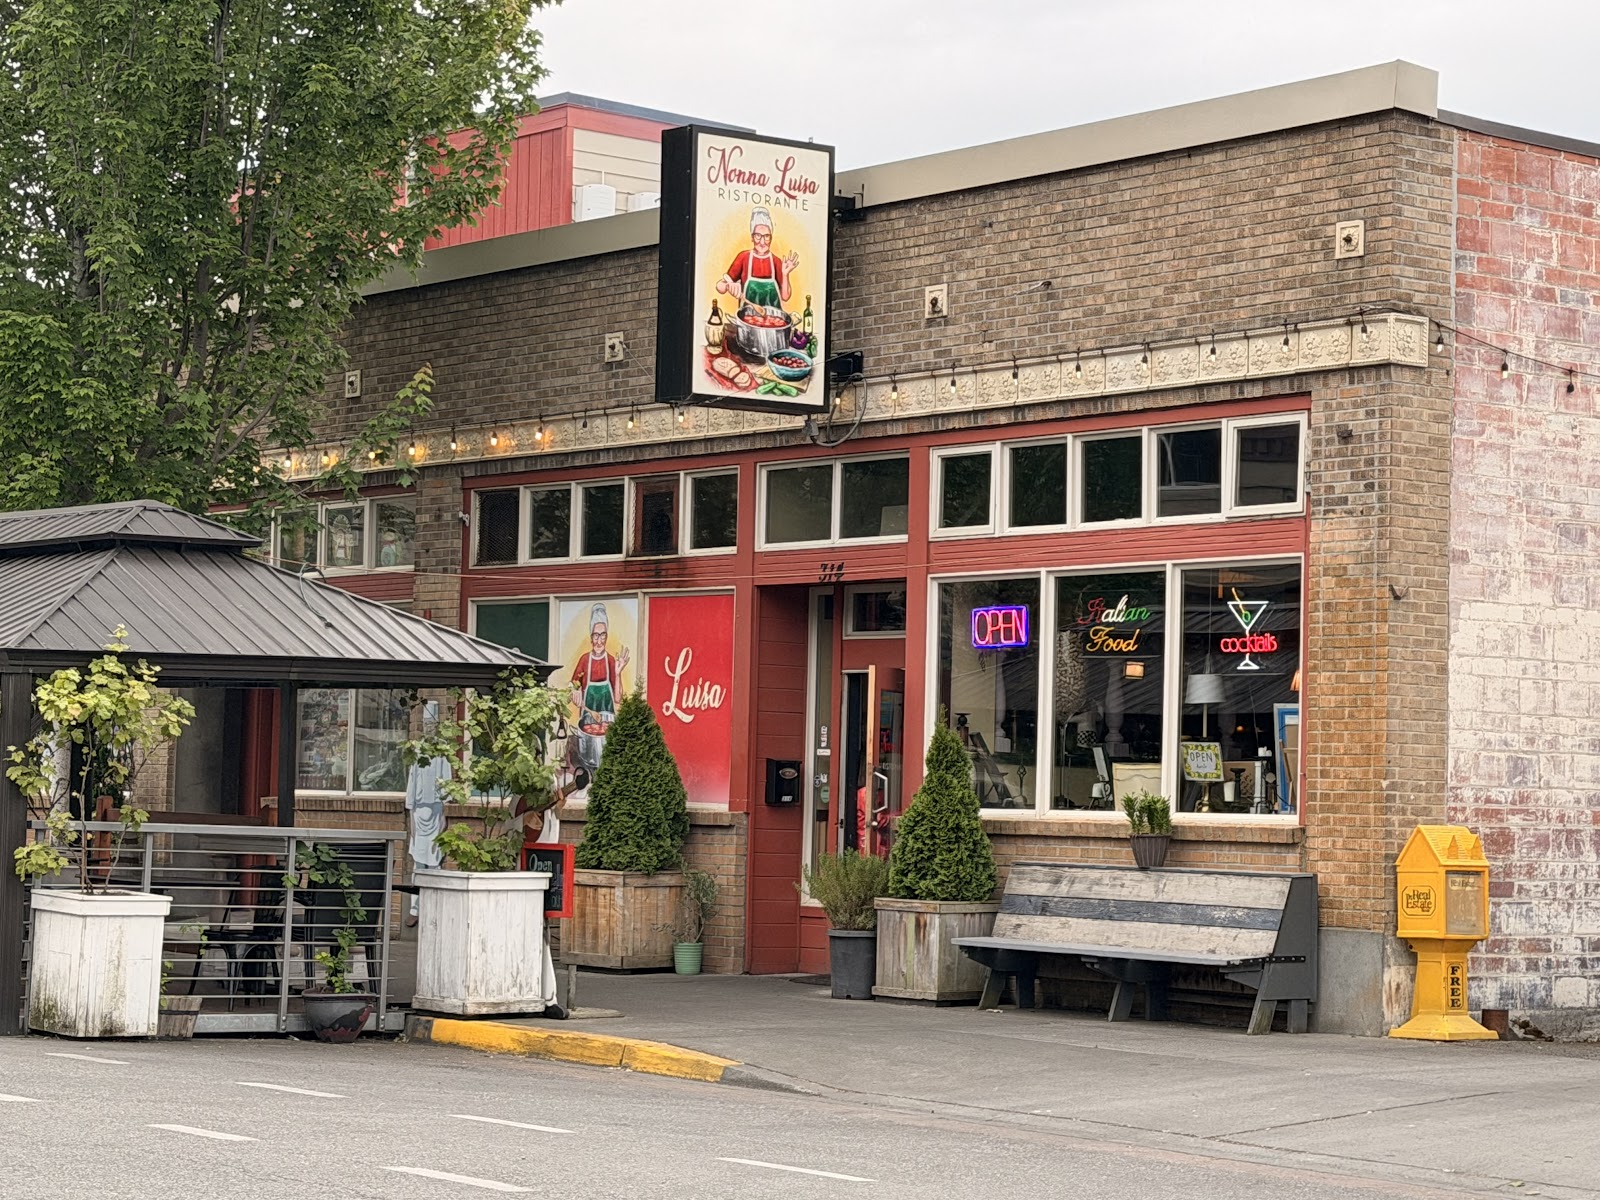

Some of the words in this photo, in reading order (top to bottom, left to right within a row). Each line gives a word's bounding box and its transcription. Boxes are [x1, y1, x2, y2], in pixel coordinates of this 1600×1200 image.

[707, 145, 770, 186] Nonna
[773, 156, 820, 200] Luisa
[718, 187, 809, 212] RISTORANTE
[1077, 594, 1150, 625] Italian
[975, 609, 1027, 645] OPEN
[1086, 626, 1141, 652] Food
[1220, 632, 1278, 653] cocktails
[662, 646, 727, 723] Luisa
[1190, 752, 1213, 762] OPEN
[529, 853, 553, 872] Open
[1405, 900, 1432, 909] Estate
[1412, 888, 1431, 901] Real
[1450, 965, 1462, 1008] FREE
